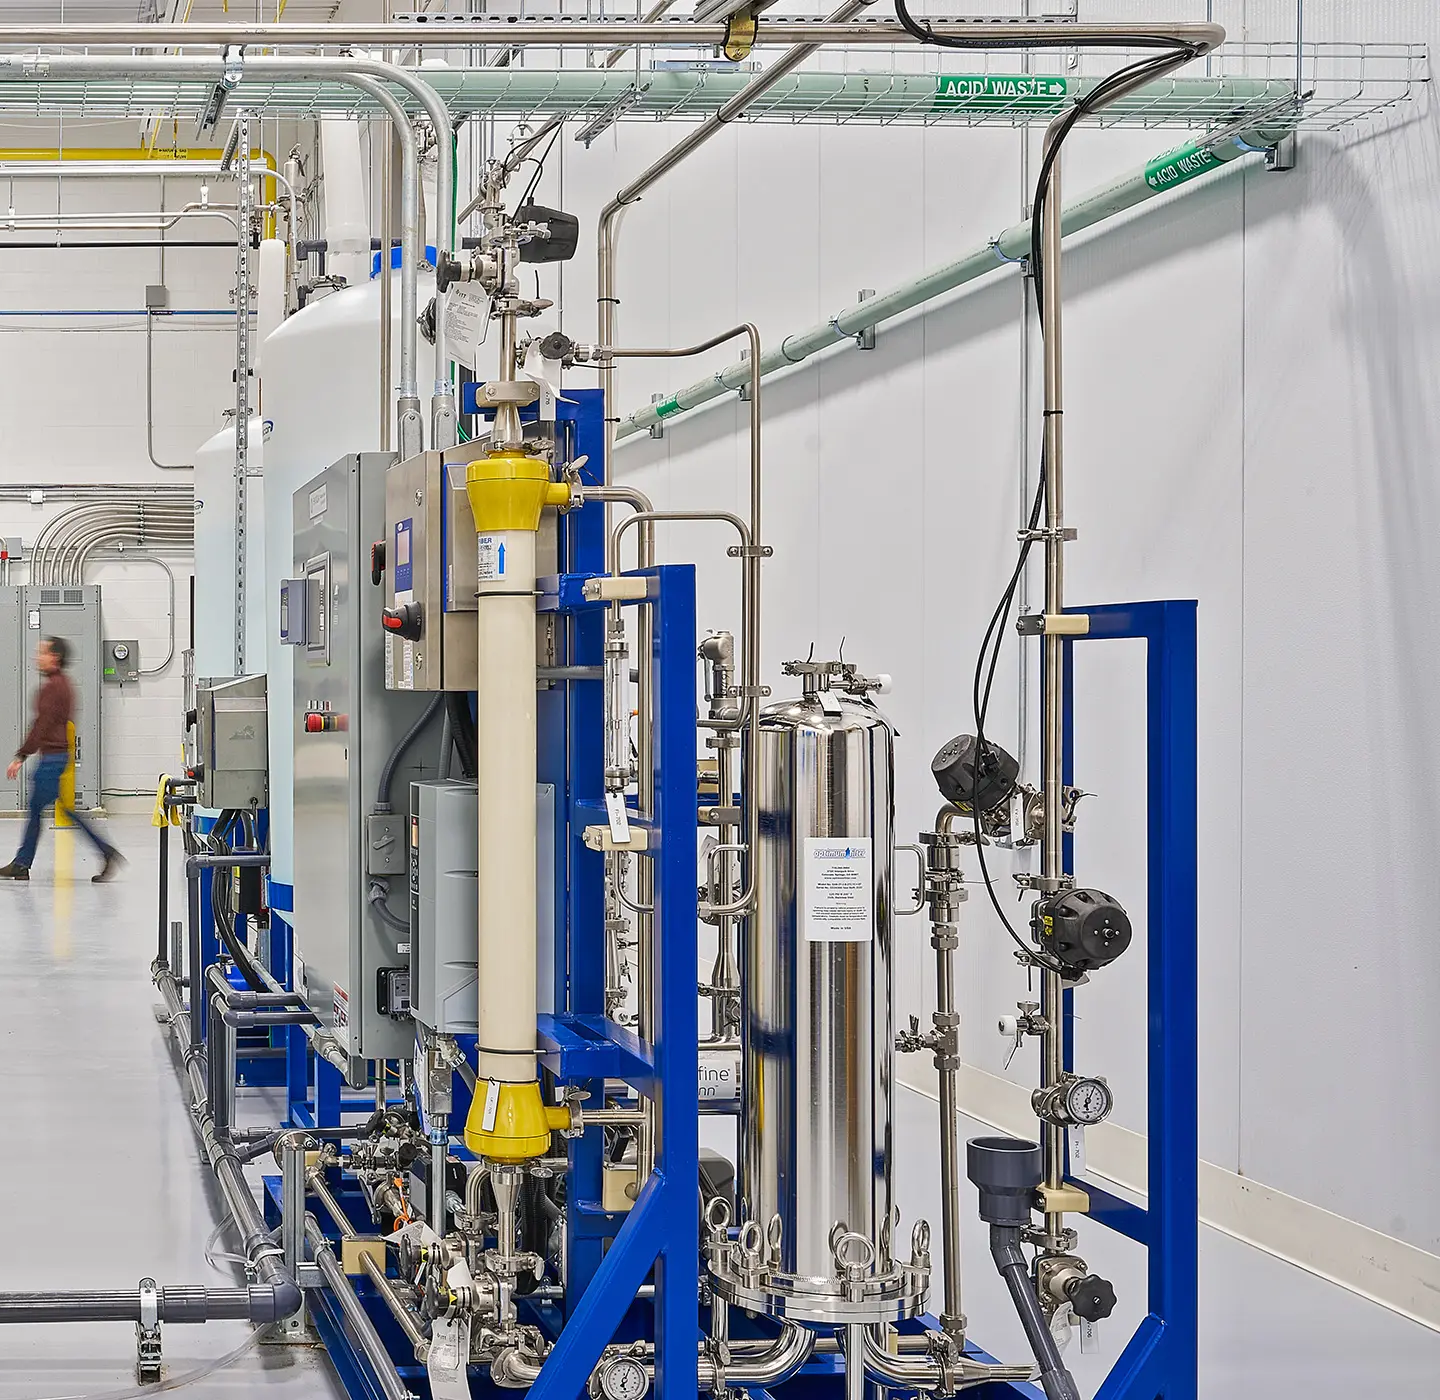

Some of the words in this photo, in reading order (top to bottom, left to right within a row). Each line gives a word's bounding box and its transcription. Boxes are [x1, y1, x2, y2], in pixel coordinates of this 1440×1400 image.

[945, 80, 983, 96] ACID
[992, 80, 1047, 96] WASTE
[1156, 165, 1179, 185] ACID
[1177, 149, 1212, 174] WASTE
[814, 848, 846, 860] optimum
